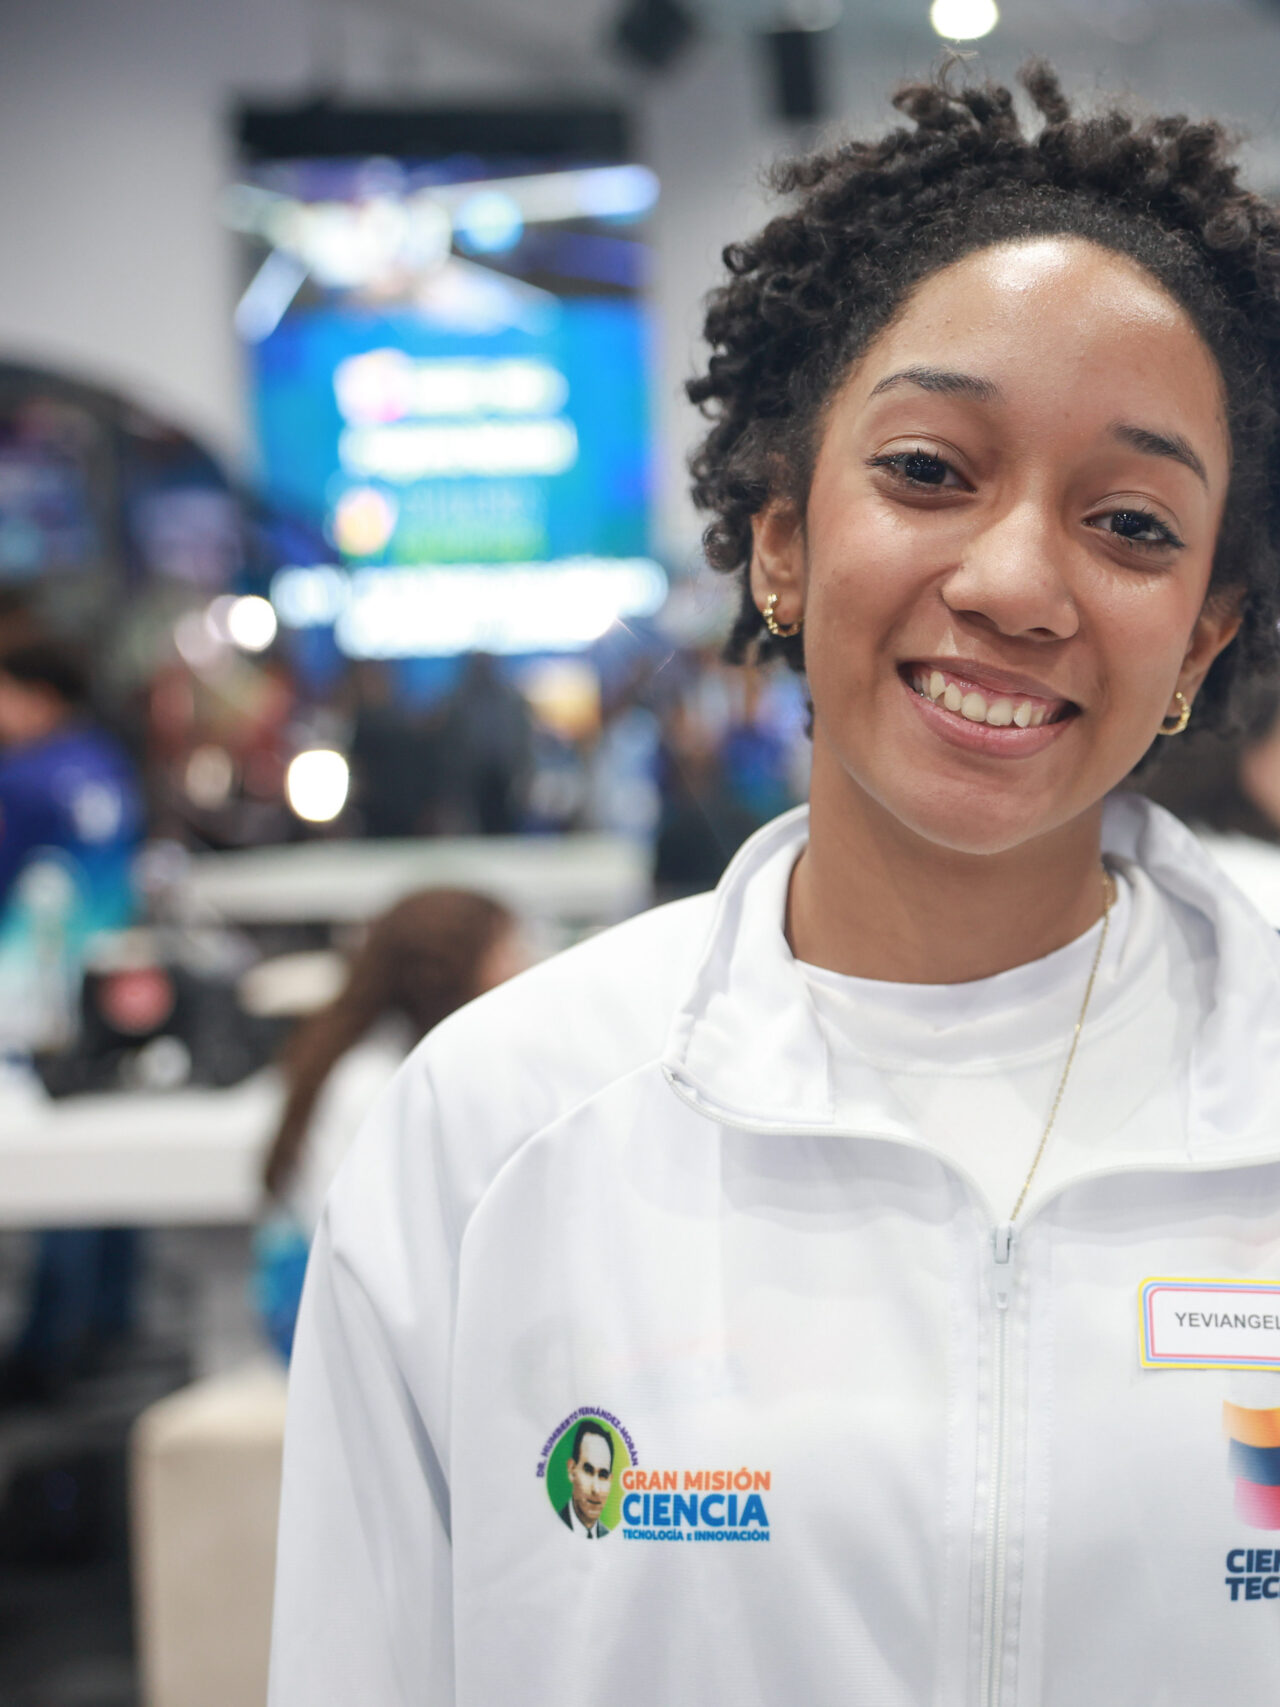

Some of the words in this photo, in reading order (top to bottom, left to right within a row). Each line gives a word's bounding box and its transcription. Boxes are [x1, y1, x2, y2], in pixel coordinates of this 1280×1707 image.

[622, 1470, 678, 1491] GRAN
[683, 1467, 771, 1491] MISIÓN
[622, 1493, 769, 1527] CIENCIA
[622, 1528, 684, 1541] TECNOLOGÍA
[694, 1529, 770, 1542] INNOVACIÓN
